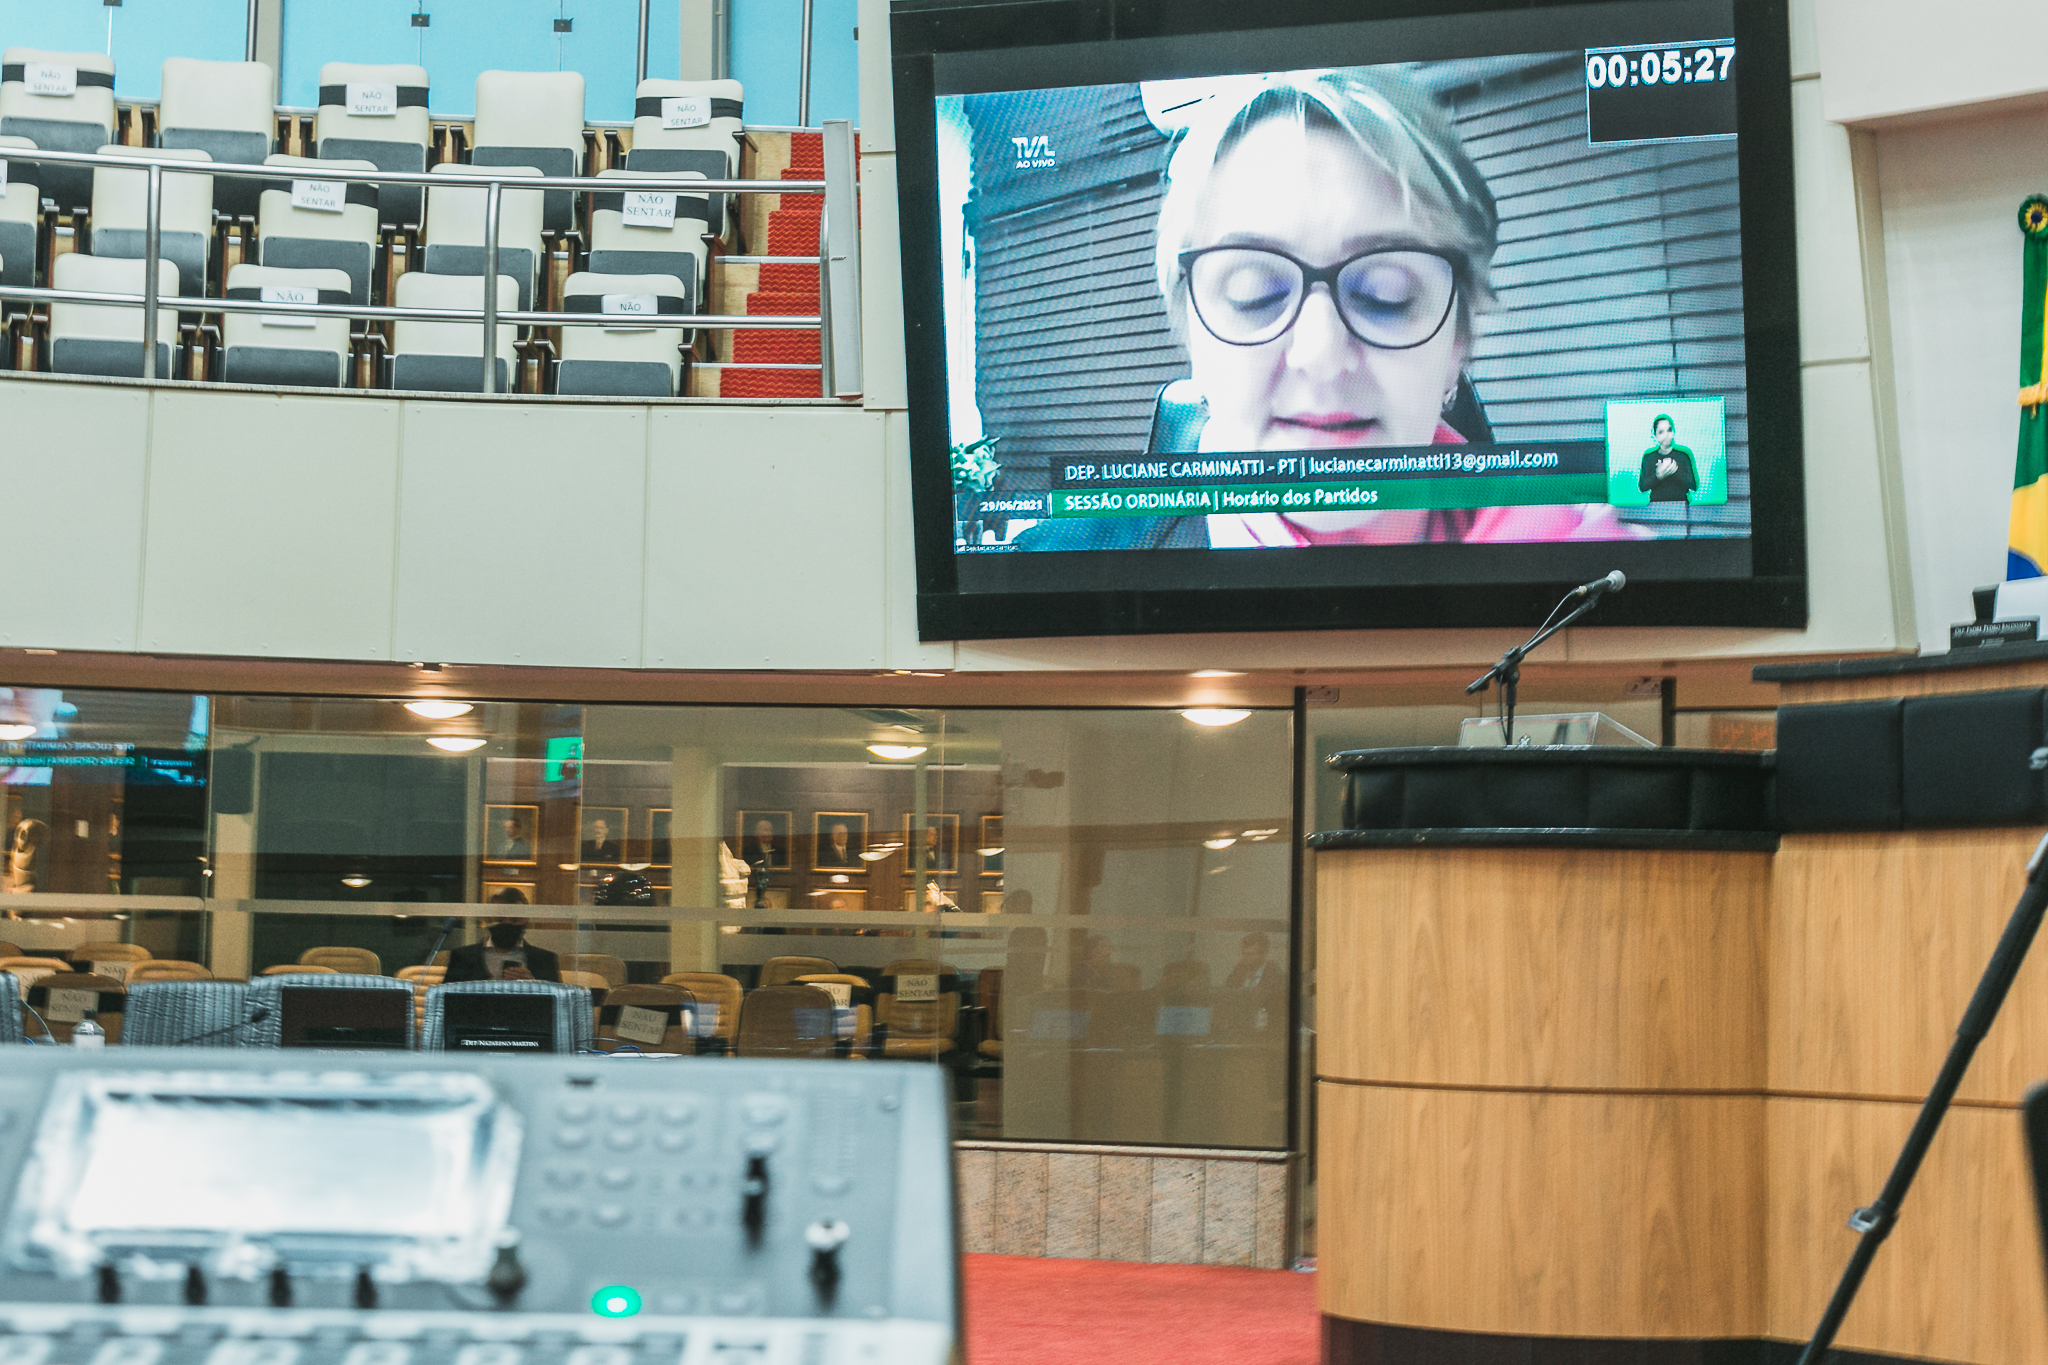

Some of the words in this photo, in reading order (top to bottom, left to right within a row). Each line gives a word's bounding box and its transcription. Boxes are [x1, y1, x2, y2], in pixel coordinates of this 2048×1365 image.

[1587, 46, 1736, 90] 00:05:27
[41, 70, 61, 80] NÃO
[33, 84, 67, 92] SENTAR
[362, 90, 382, 100] NÃO
[355, 105, 389, 113] SENTAR
[677, 104, 697, 112] NÃO
[671, 118, 703, 126] SENTAR
[1015, 160, 1031, 169] AO
[1031, 159, 1056, 168] VIVO
[310, 183, 330, 193] NÃO
[301, 196, 336, 207] SENTAR
[638, 193, 664, 204] NÃO
[626, 206, 672, 218] SENTAR
[276, 289, 304, 302] NÃO
[620, 302, 641, 311] NÃO
[1065, 464, 1100, 480] DEP.
[1102, 461, 1168, 479] LUCIANE
[1170, 458, 1265, 477] CARMINATTI
[1277, 458, 1298, 475] PT
[1308, 450, 1559, 475] lucianecarminatti13@gmail.com
[1065, 492, 1122, 511] SESSÃO
[1125, 489, 1212, 508] ORDINÁRIA
[1223, 490, 1279, 507] Horário
[1283, 488, 1311, 505] dos
[1314, 486, 1378, 505] Partidos
[980, 499, 1043, 512] 29/06/2021
[907, 977, 928, 987] NÃO
[899, 989, 936, 998] SENTAR
